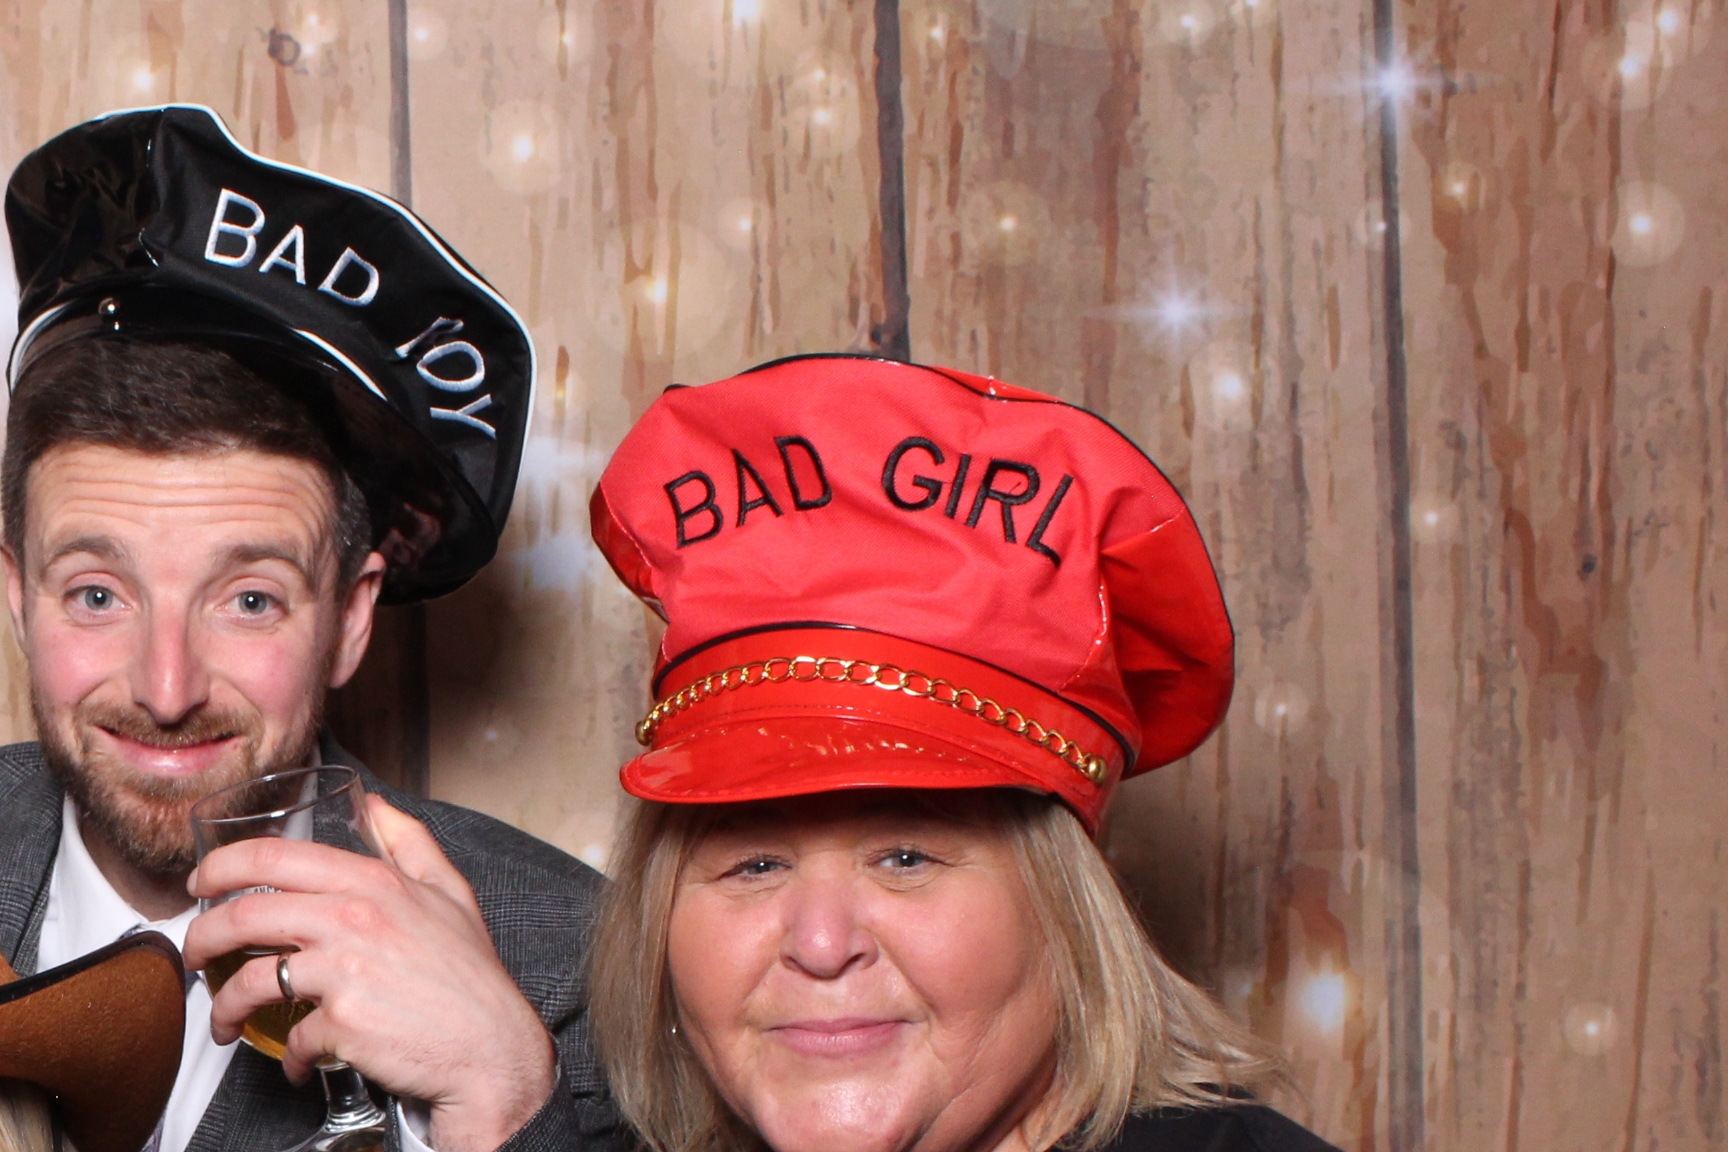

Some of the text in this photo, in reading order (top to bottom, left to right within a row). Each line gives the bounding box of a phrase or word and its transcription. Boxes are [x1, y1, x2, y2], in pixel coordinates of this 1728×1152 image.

[204, 188, 380, 306] BAD
[663, 435, 1075, 569] BAD GIRL
